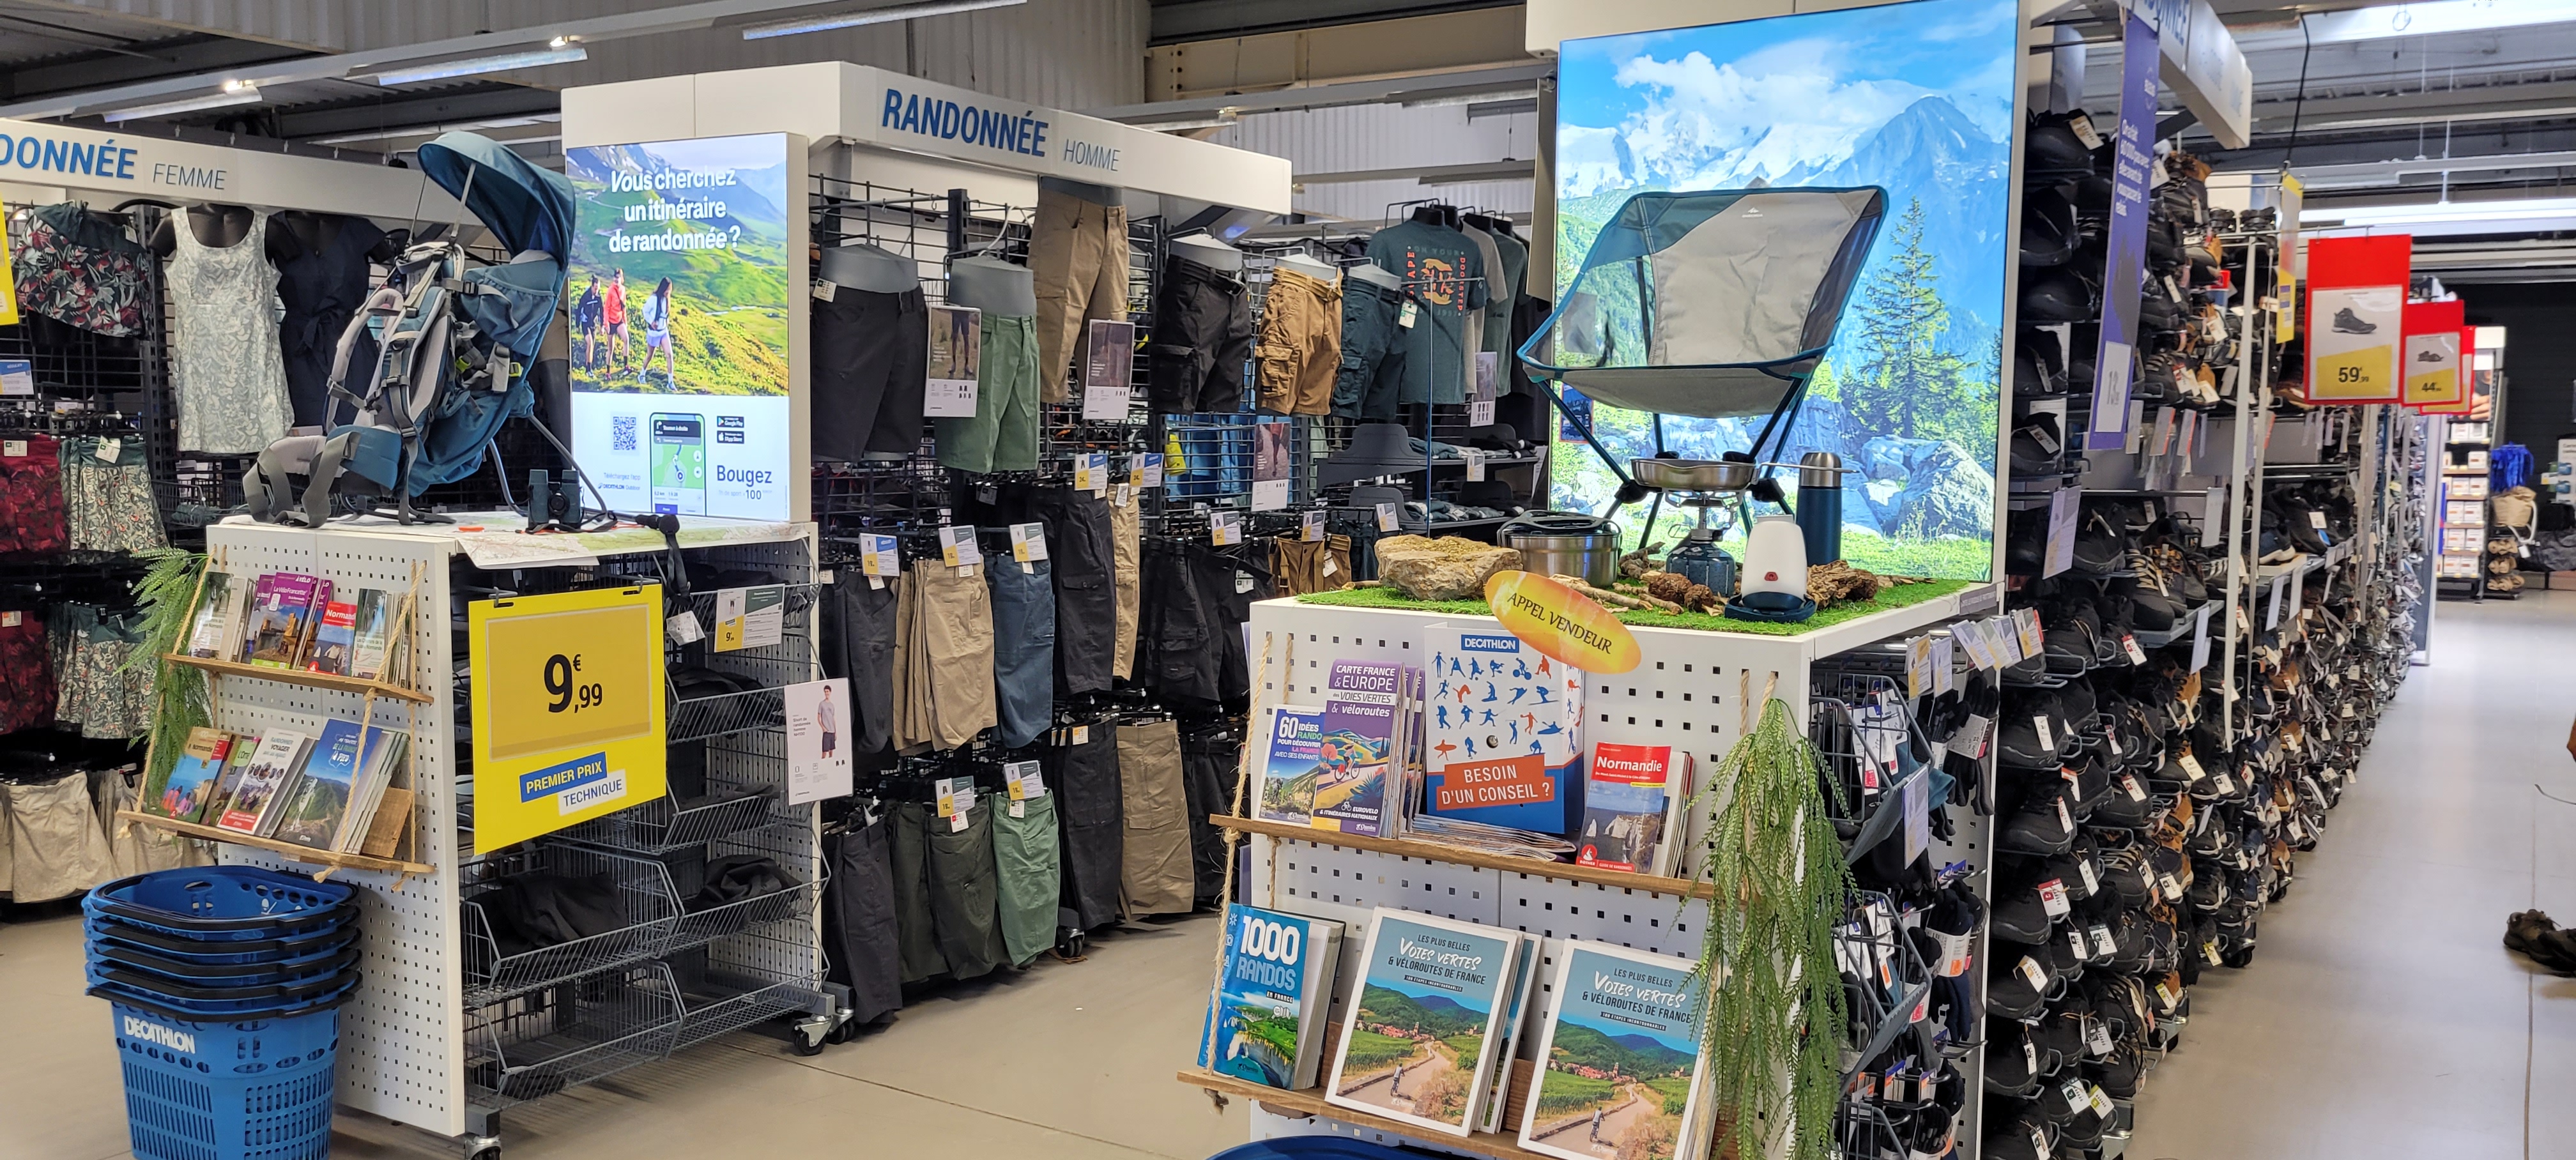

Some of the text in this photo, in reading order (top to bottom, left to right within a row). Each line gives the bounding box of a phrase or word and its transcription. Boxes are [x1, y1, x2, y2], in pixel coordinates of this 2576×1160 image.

[882, 88, 1121, 172] RANDONNÉE HOMME
[153, 163, 227, 190] FEMME
[611, 167, 736, 192] Vous cherchez
[624, 195, 726, 222] un itinéraire
[609, 225, 741, 252] de randonnée ?
[717, 465, 772, 487] Bougez
[746, 489, 762, 500] 100
[1507, 592, 1612, 654] APPEL VENDEUR
[1464, 637, 1515, 651] DECATHLON
[1336, 665, 1396, 676] CARTE FRANCE
[1334, 675, 1394, 691] & EUROPE
[1340, 691, 1362, 701] VOIES
[1363, 693, 1392, 703] VERTES
[1331, 703, 1390, 717] & véloroutes
[1278, 716, 1319, 738] 60 IDÉES
[1298, 731, 1322, 740] RANDO
[1292, 739, 1321, 748] DÉCOUVRIR
[1464, 765, 1517, 783] BESOIN
[1597, 756, 1662, 772] Normandie
[526, 761, 602, 794] PREMIER PRIX
[563, 779, 623, 807] TECHNIQUE
[1441, 782, 1550, 805] D'UN CONSEIL ?
[1353, 806, 1378, 814] EUROVELO
[1240, 915, 1301, 966] 1000
[1418, 934, 1470, 952] LES PLUS BELLES
[1400, 936, 1482, 971] VOIES VERTES
[1236, 956, 1296, 991] RANDOS
[1388, 956, 1487, 985] & VÉLOROUTES DE FRANCE
[1614, 968, 1673, 988] LES PLUS BELLES
[1274, 993, 1293, 1003] FRANCE
[1595, 970, 1687, 1009] VOIES VERTES
[1582, 991, 1692, 1024] & VÉLOROUTES DE FRANCE
[125, 1016, 195, 1054] DECATHLON
